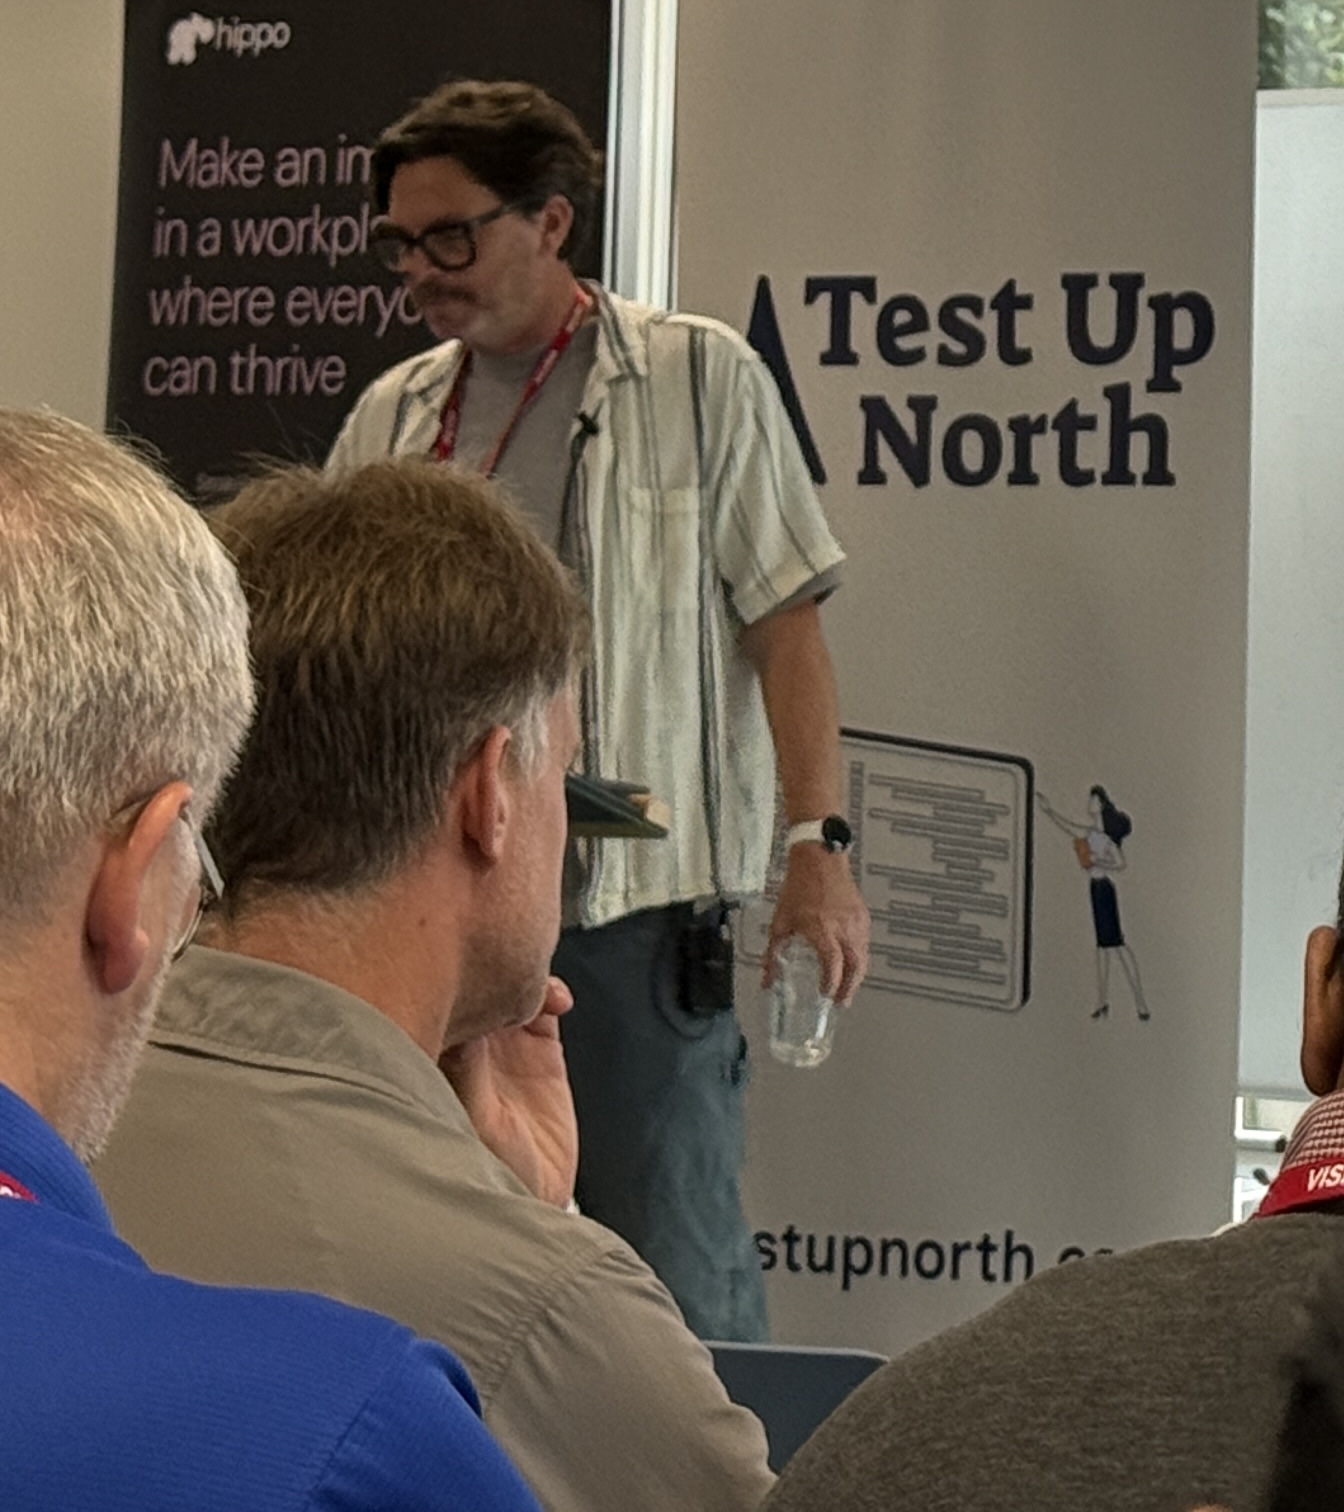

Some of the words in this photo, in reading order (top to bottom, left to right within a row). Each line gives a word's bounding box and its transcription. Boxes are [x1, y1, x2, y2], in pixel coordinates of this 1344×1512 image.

[214, 17, 292, 56] hippo
[160, 138, 264, 187] Make
[273, 147, 326, 187] an
[154, 208, 187, 256] in
[198, 219, 220, 255] a
[149, 276, 275, 327] where
[804, 276, 1033, 367] Test
[1061, 272, 1214, 393] Up
[143, 357, 216, 396] can
[230, 345, 347, 395] thrive
[858, 382, 1175, 487] North
